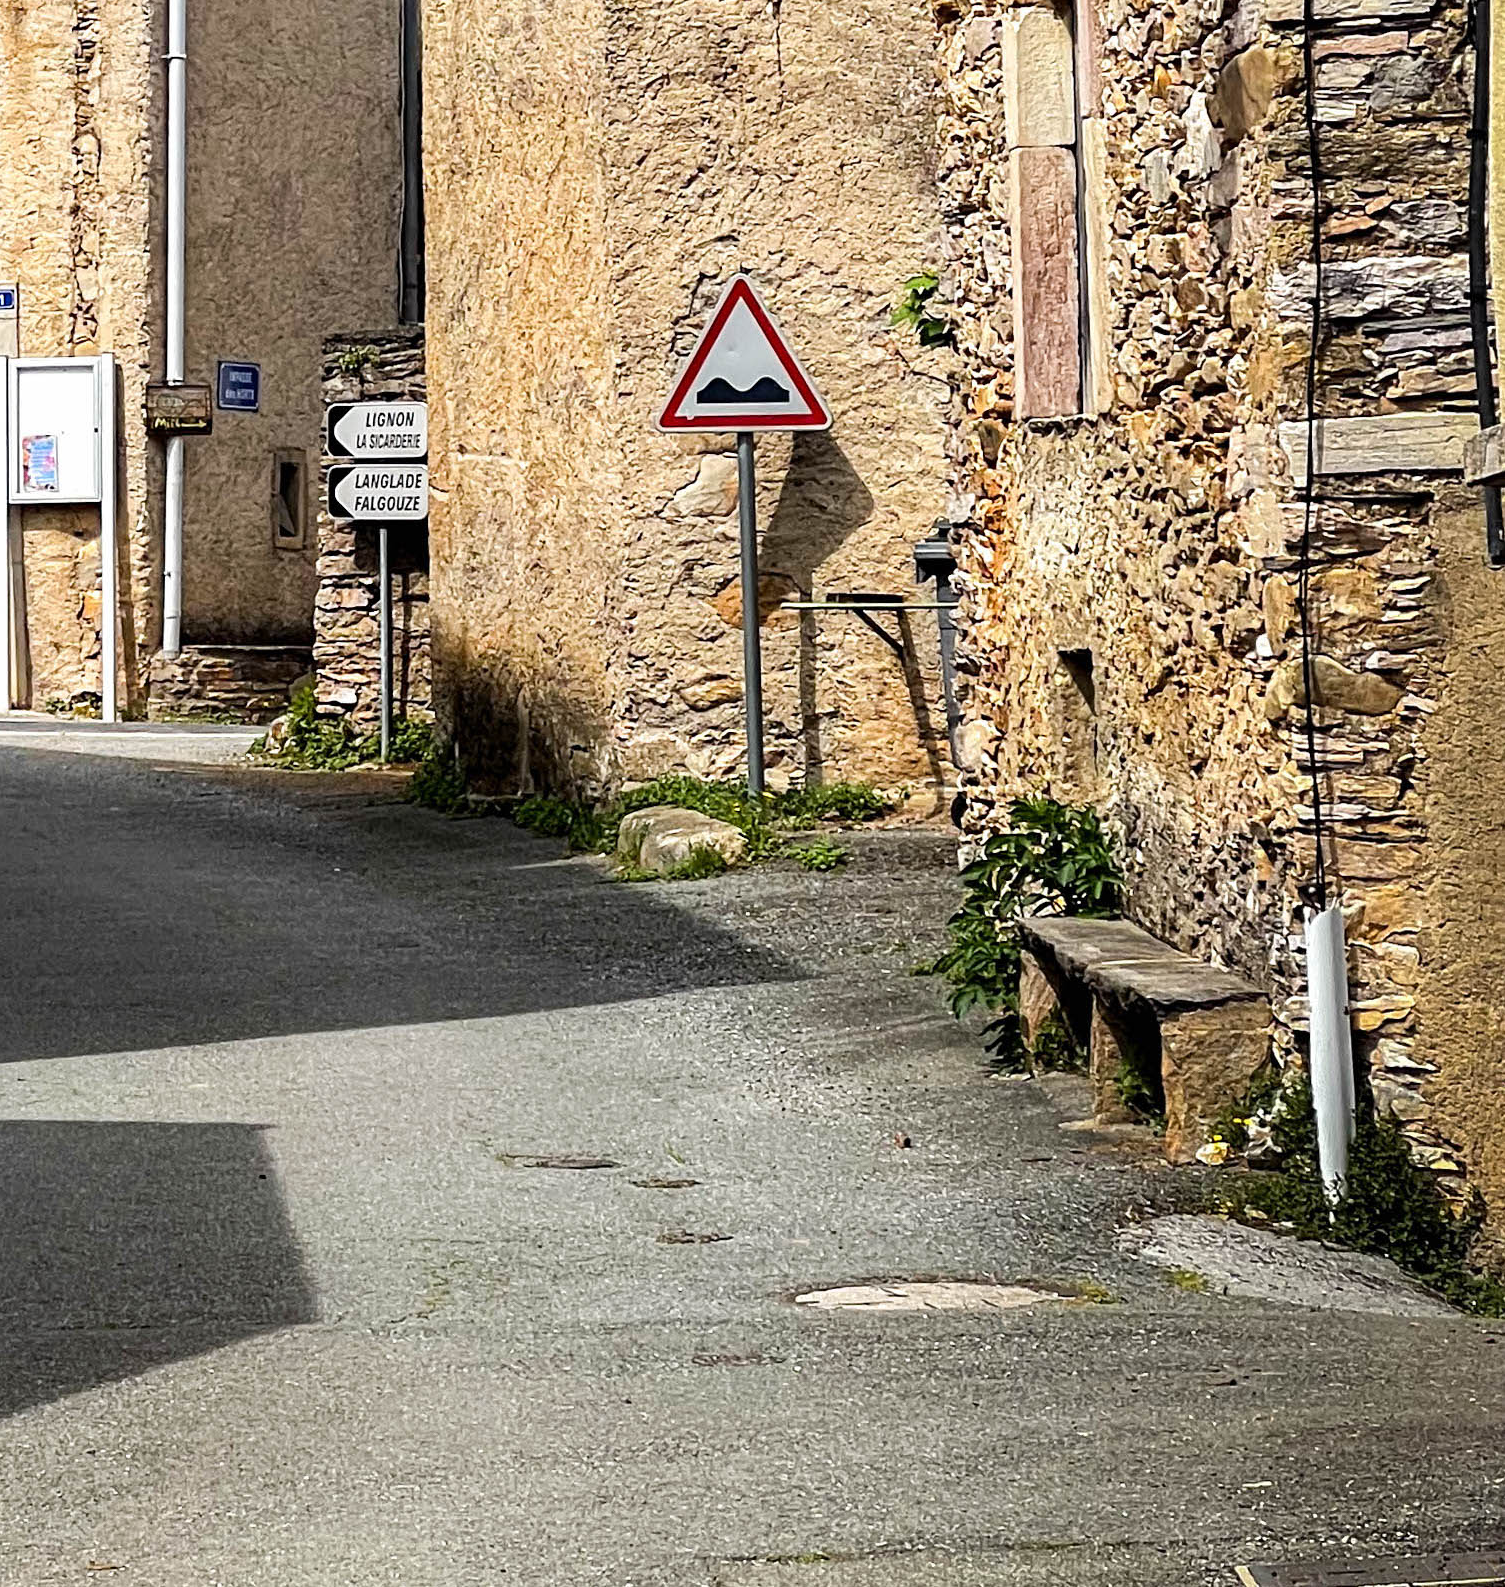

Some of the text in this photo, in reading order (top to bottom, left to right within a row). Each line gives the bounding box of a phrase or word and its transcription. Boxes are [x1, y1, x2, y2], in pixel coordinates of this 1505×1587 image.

[0, 294, 5, 306] 1
[365, 411, 415, 427] LIGNON
[356, 434, 367, 449] LA
[354, 473, 423, 489] LANGLADE
[354, 495, 421, 511] FALGOUZE
